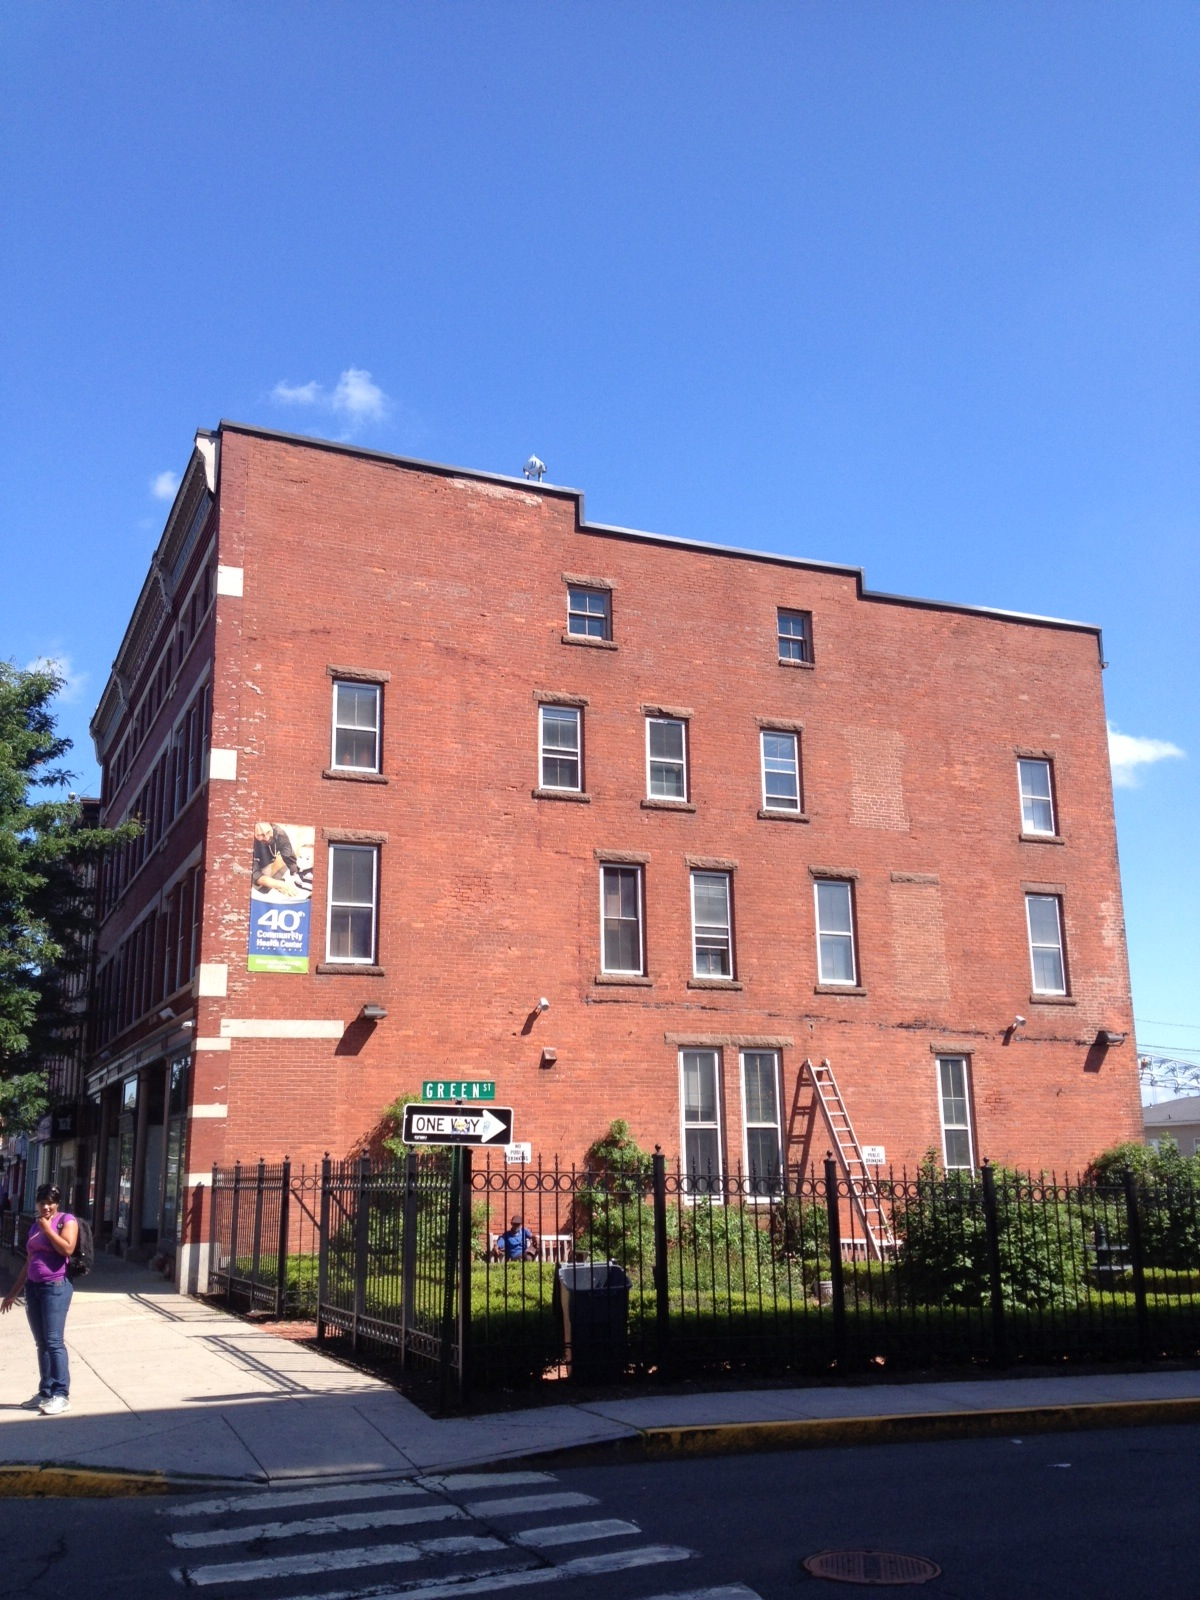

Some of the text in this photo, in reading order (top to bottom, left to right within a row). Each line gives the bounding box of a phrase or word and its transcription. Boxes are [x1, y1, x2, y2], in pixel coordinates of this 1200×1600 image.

[257, 930, 303, 941] Community
[257, 939, 302, 948] Health Center
[426, 1083, 492, 1098] GREEN ST
[416, 1117, 480, 1133] ONE WY
